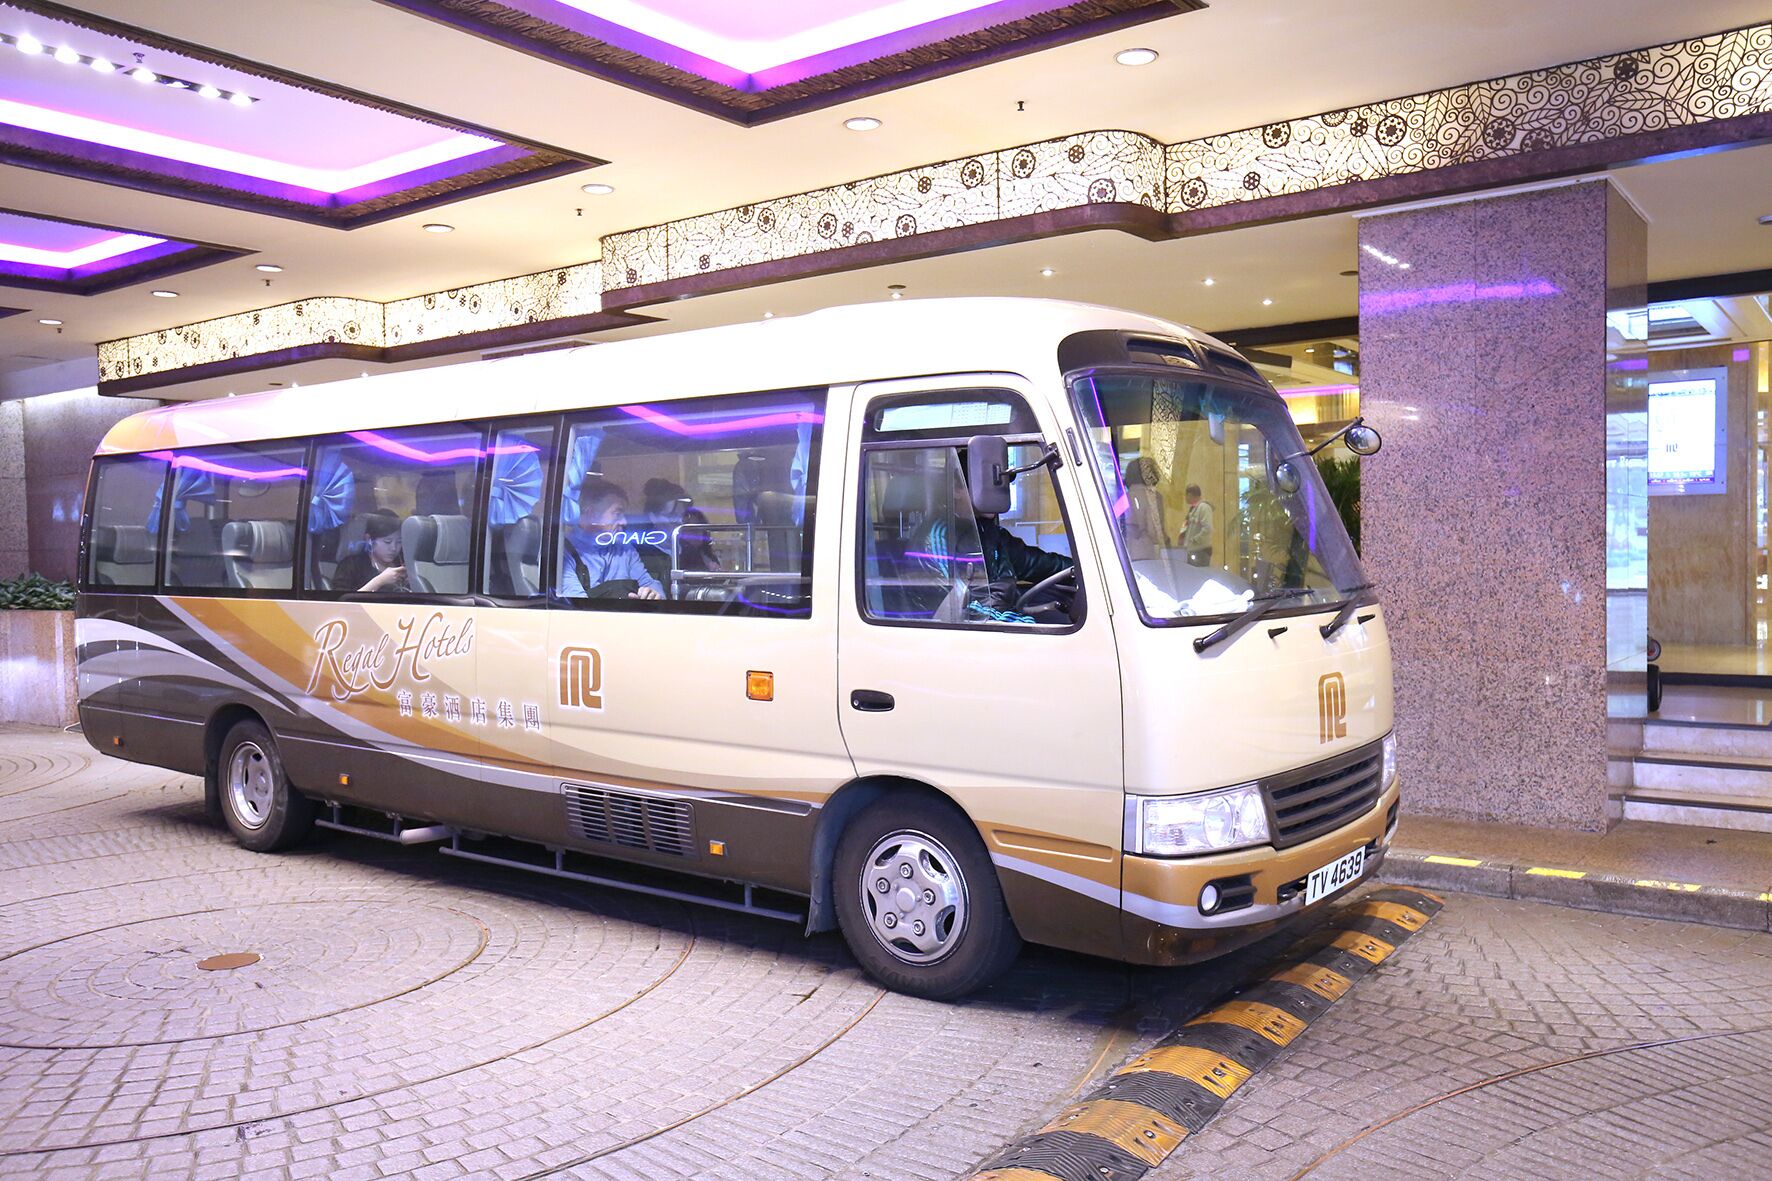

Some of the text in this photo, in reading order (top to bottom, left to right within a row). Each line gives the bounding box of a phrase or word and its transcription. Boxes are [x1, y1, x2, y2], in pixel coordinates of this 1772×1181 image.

[306, 612, 474, 700] Regal Hotels
[396, 690, 540, 730] 富豪酒店集團
[1311, 851, 1362, 898] TV 4639
